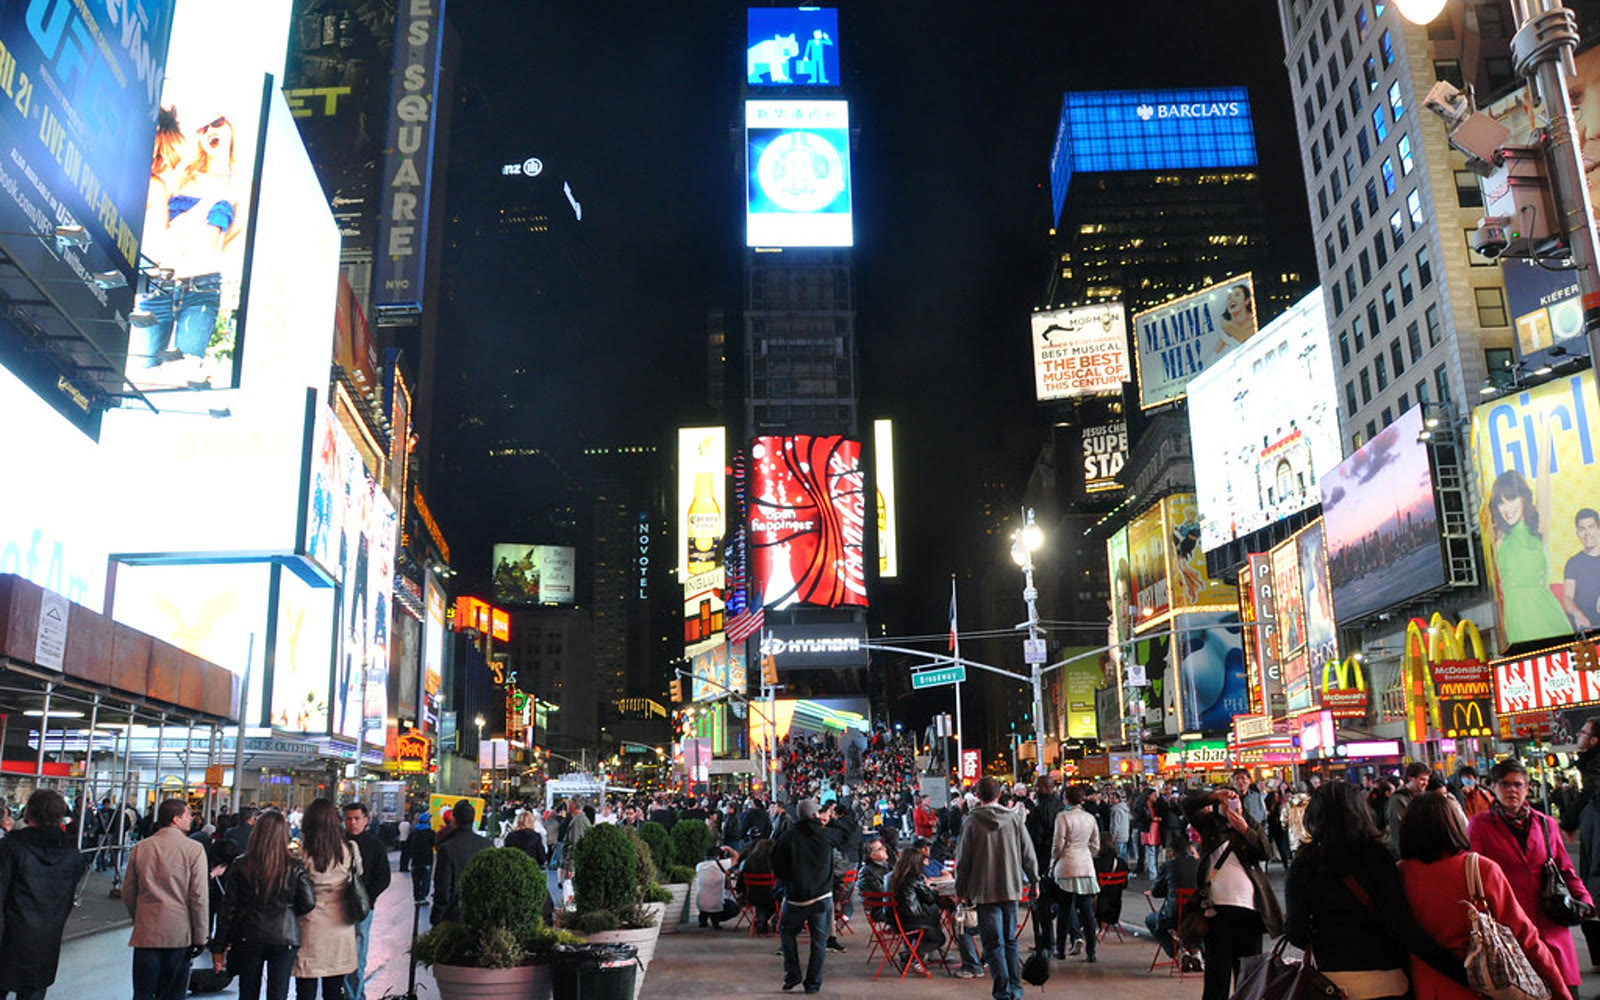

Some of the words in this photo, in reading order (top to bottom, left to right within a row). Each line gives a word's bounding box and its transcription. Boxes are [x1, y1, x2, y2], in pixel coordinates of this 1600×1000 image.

[1157, 102, 1239, 119] BARCLAYS
[389, 64, 429, 255] SQUARE
[15, 72, 33, 119] 21
[39, 104, 66, 164] LIVE
[64, 141, 82, 188] ON
[80, 162, 139, 269] PAY-PER-VIEW
[386, 280, 410, 289] NYC
[1540, 284, 1579, 305] KIEFER
[1144, 303, 1215, 354] MAMMA
[1041, 348, 1068, 360] BEST
[1072, 342, 1122, 355] MUSICAL
[1043, 357, 1076, 372] THE
[1080, 352, 1122, 368] BEST
[1161, 338, 1204, 383] MIA!
[1043, 368, 1102, 382] MUSICAL
[1104, 365, 1124, 376] OF
[1045, 381, 1070, 391] THIS
[1071, 375, 1124, 388] CENTURY
[1082, 426, 1107, 438] JESUS
[1488, 374, 1595, 479] Girl
[766, 508, 796, 520] open
[751, 518, 815, 532] happiness
[639, 523, 649, 599] NOVOTEL
[788, 637, 860, 653] HYUNDAI
[1435, 665, 1489, 674] McDonald's
[919, 672, 957, 685] Broadway
[1323, 693, 1366, 701] McDonald's
[963, 751, 978, 777] tkts
